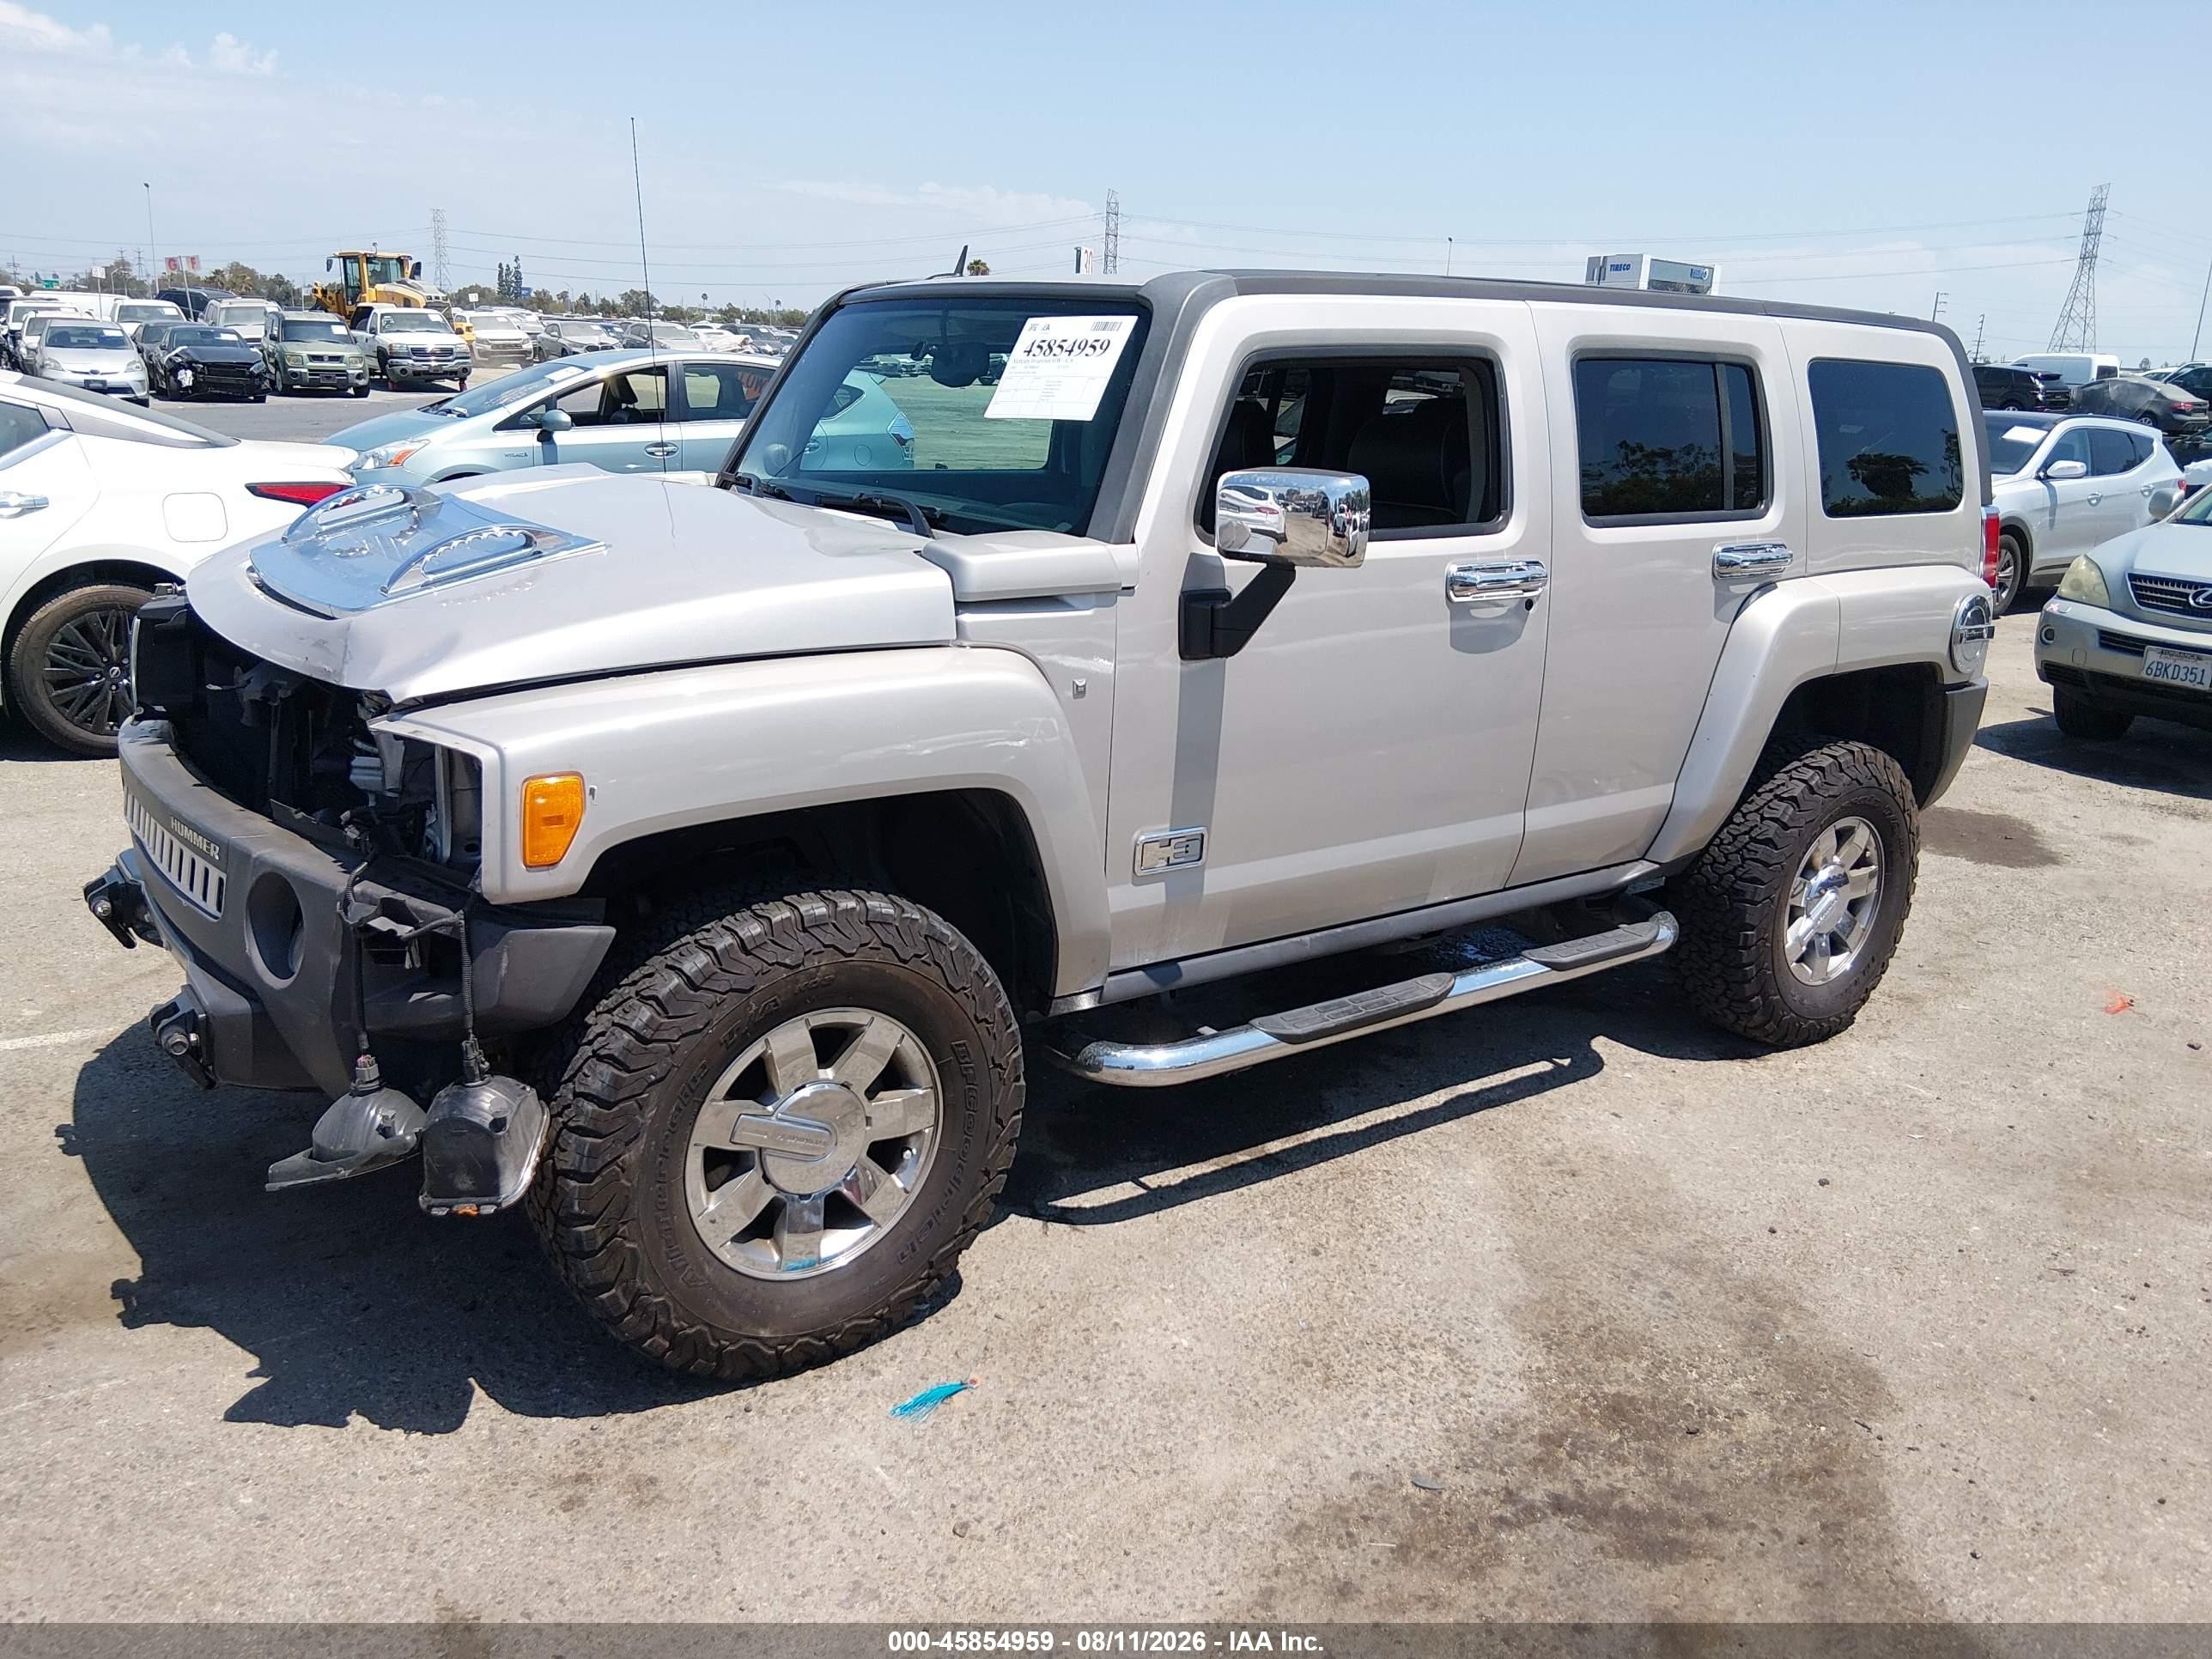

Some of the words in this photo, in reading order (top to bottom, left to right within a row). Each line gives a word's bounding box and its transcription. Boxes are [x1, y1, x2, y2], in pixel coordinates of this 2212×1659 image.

[167, 258, 178, 271] G
[1609, 263, 1631, 272] TIRECO
[1023, 338, 1111, 357] 45854959
[2145, 660, 2206, 685] 6BKD351
[171, 817, 220, 860] HUMMER
[888, 1040, 981, 1266] BFGoodrich
